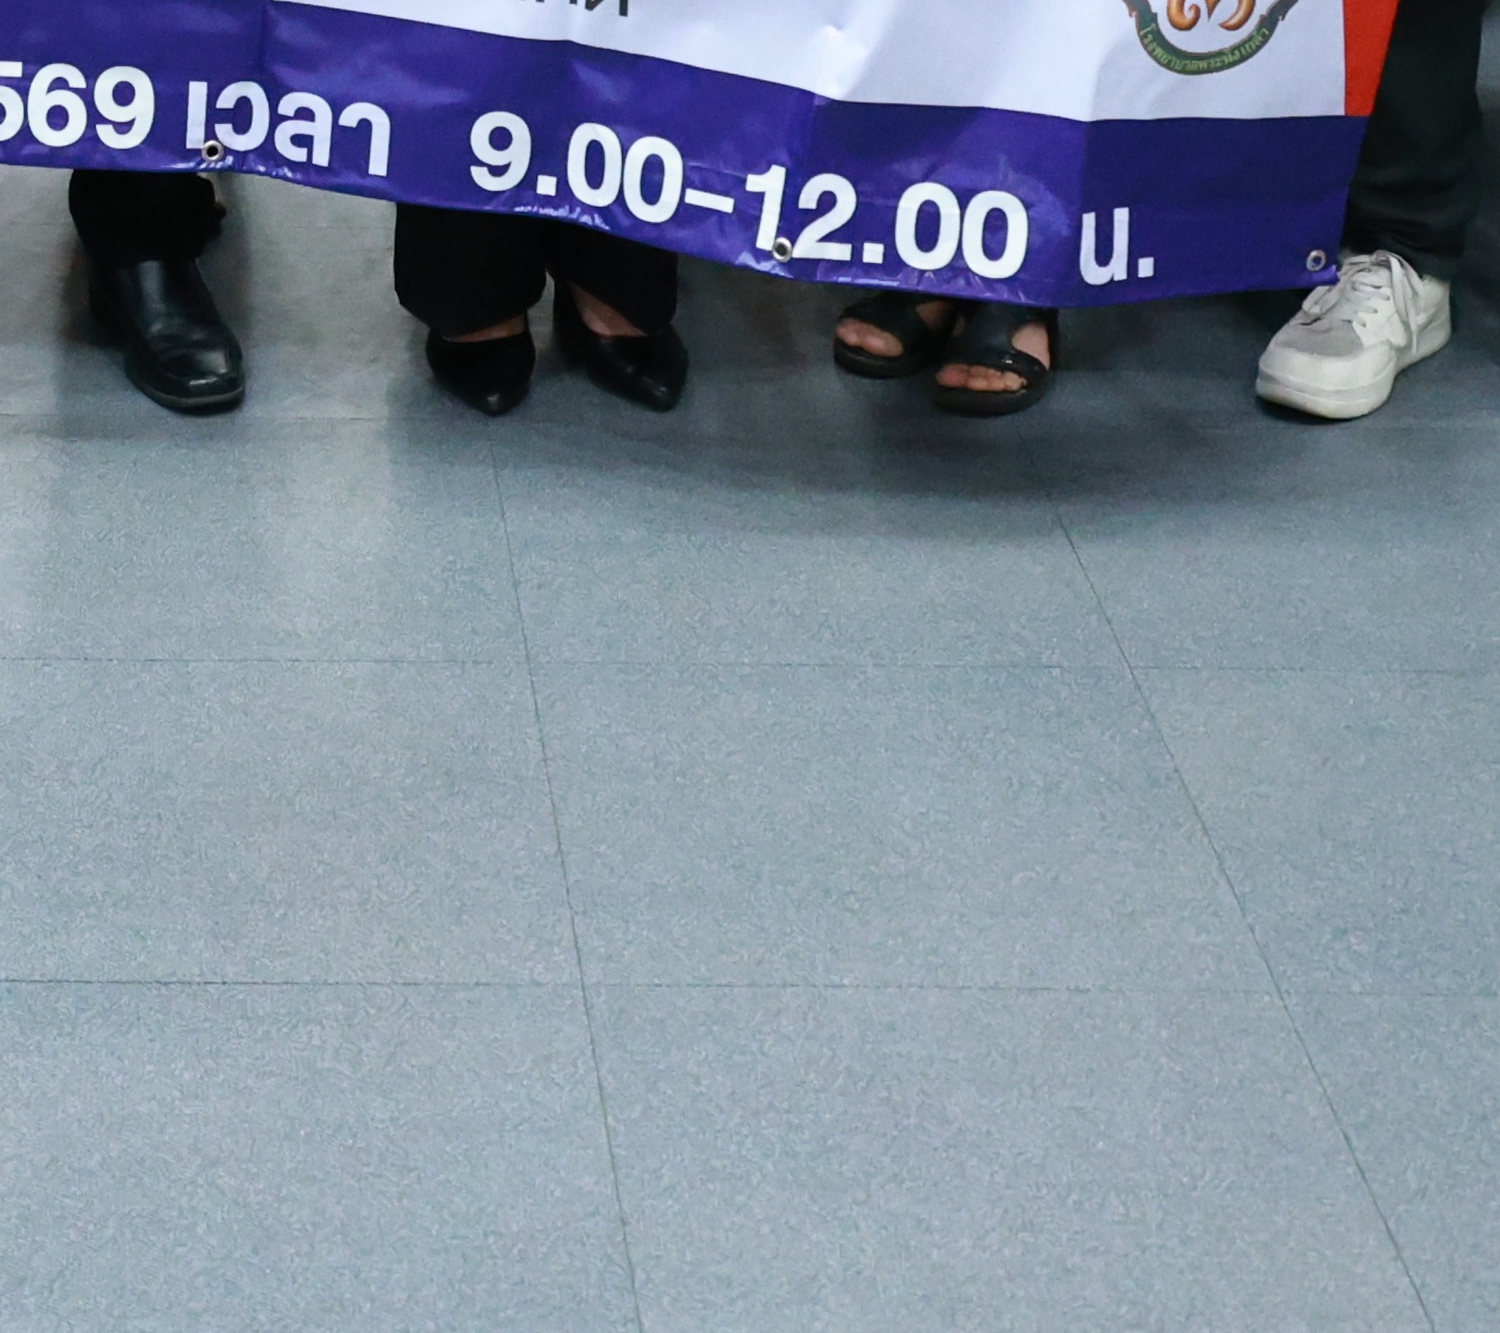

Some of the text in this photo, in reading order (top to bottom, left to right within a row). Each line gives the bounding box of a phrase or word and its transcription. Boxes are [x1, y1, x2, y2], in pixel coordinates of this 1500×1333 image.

[185, 81, 391, 178] เวลา
[470, 111, 1028, 279] 9.00-12.00
[1079, 207, 1154, 286] น.
